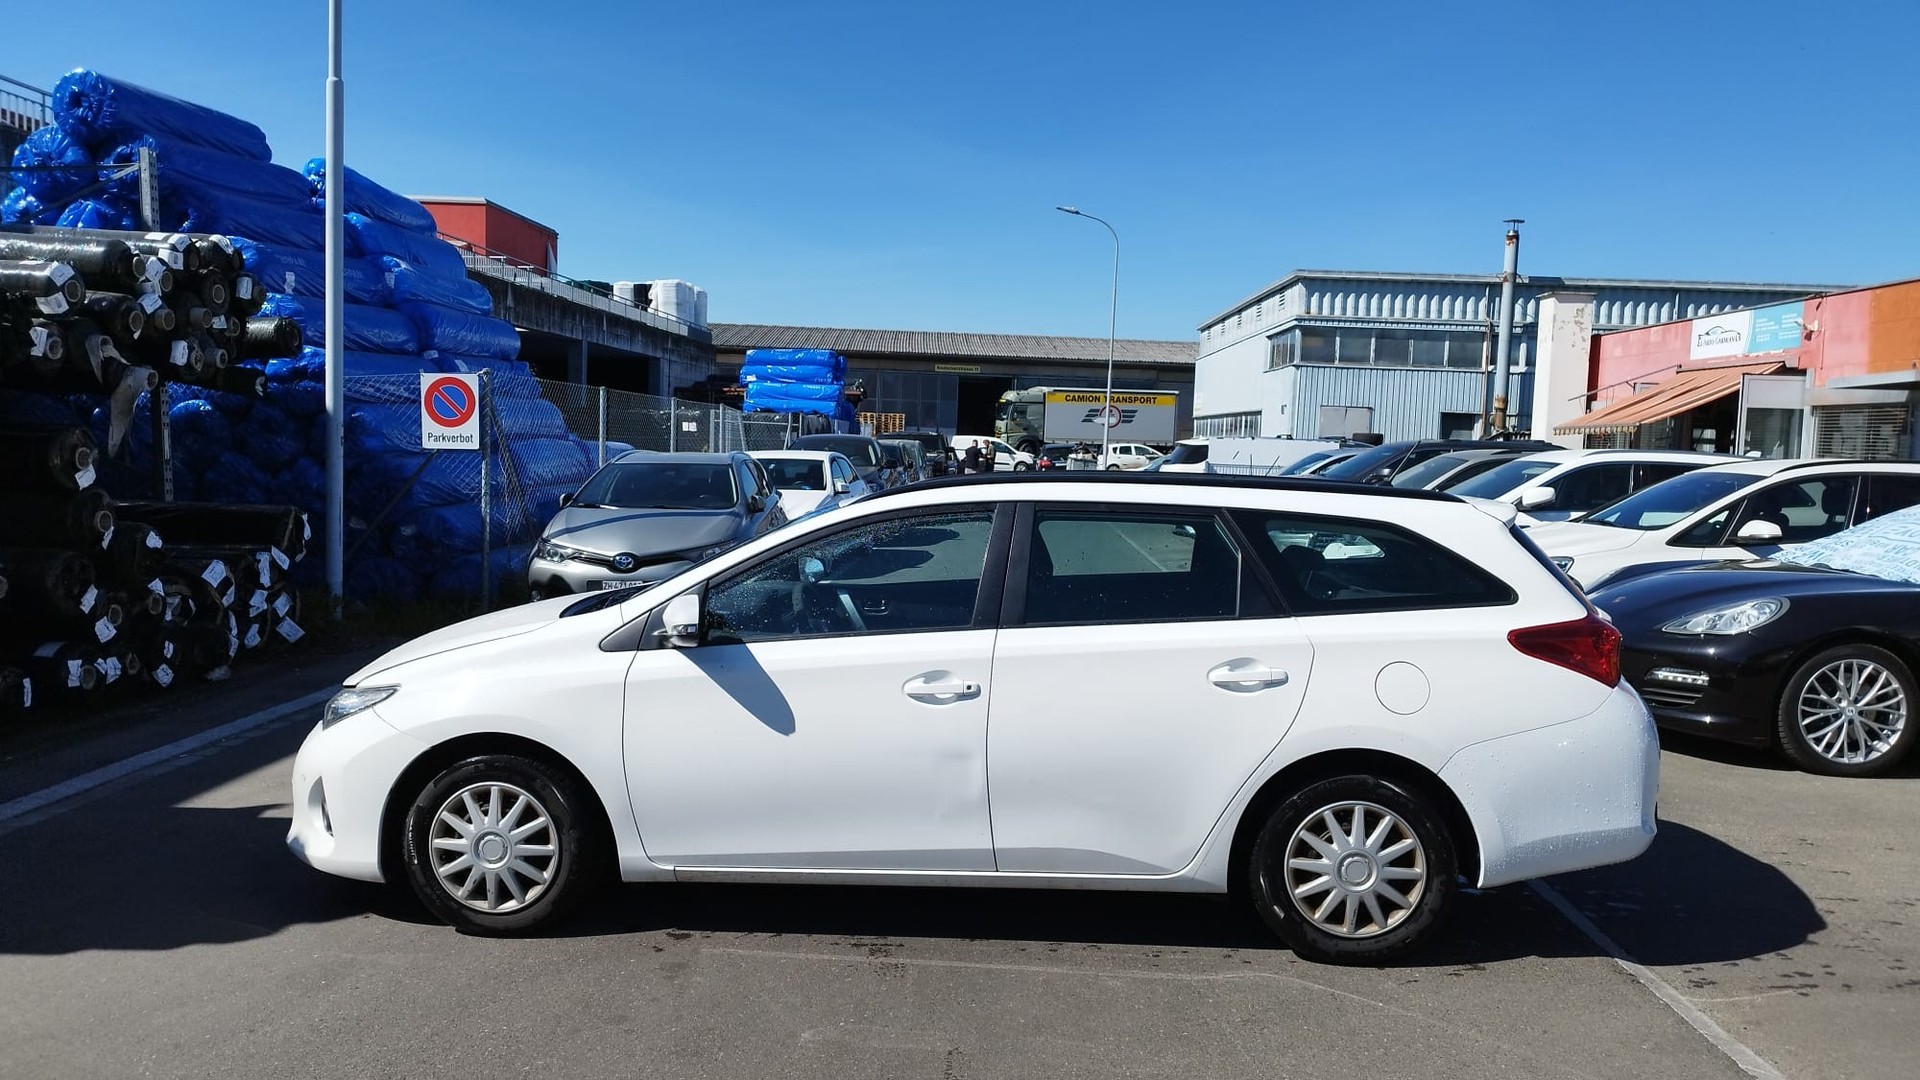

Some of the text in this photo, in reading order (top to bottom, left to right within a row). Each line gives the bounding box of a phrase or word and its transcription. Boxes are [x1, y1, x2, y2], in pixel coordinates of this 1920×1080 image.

[1064, 395, 1157, 404] CAMION TRANSPORT
[427, 432, 474, 443] Parkverbot
